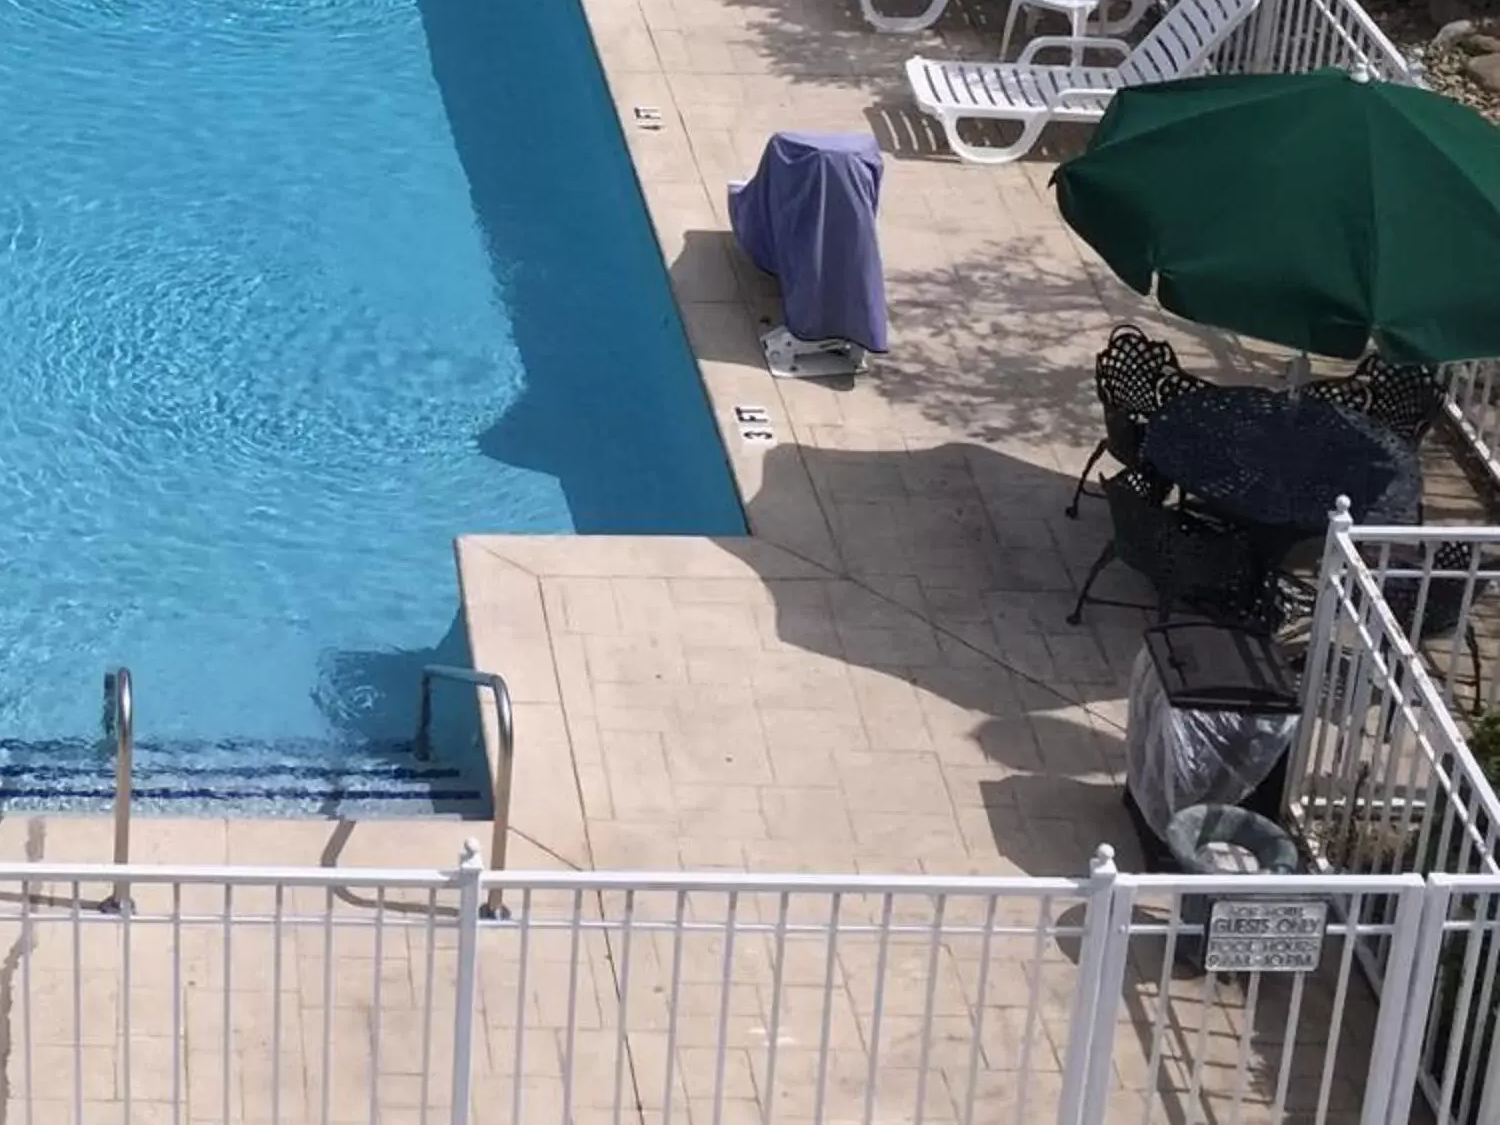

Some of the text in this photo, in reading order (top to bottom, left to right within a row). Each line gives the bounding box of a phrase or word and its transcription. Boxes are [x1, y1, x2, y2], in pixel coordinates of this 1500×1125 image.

[735, 407, 773, 439] 3 FT
[1213, 918, 1318, 934] GUESTS ONLY
[1209, 941, 1255, 954] POOL
